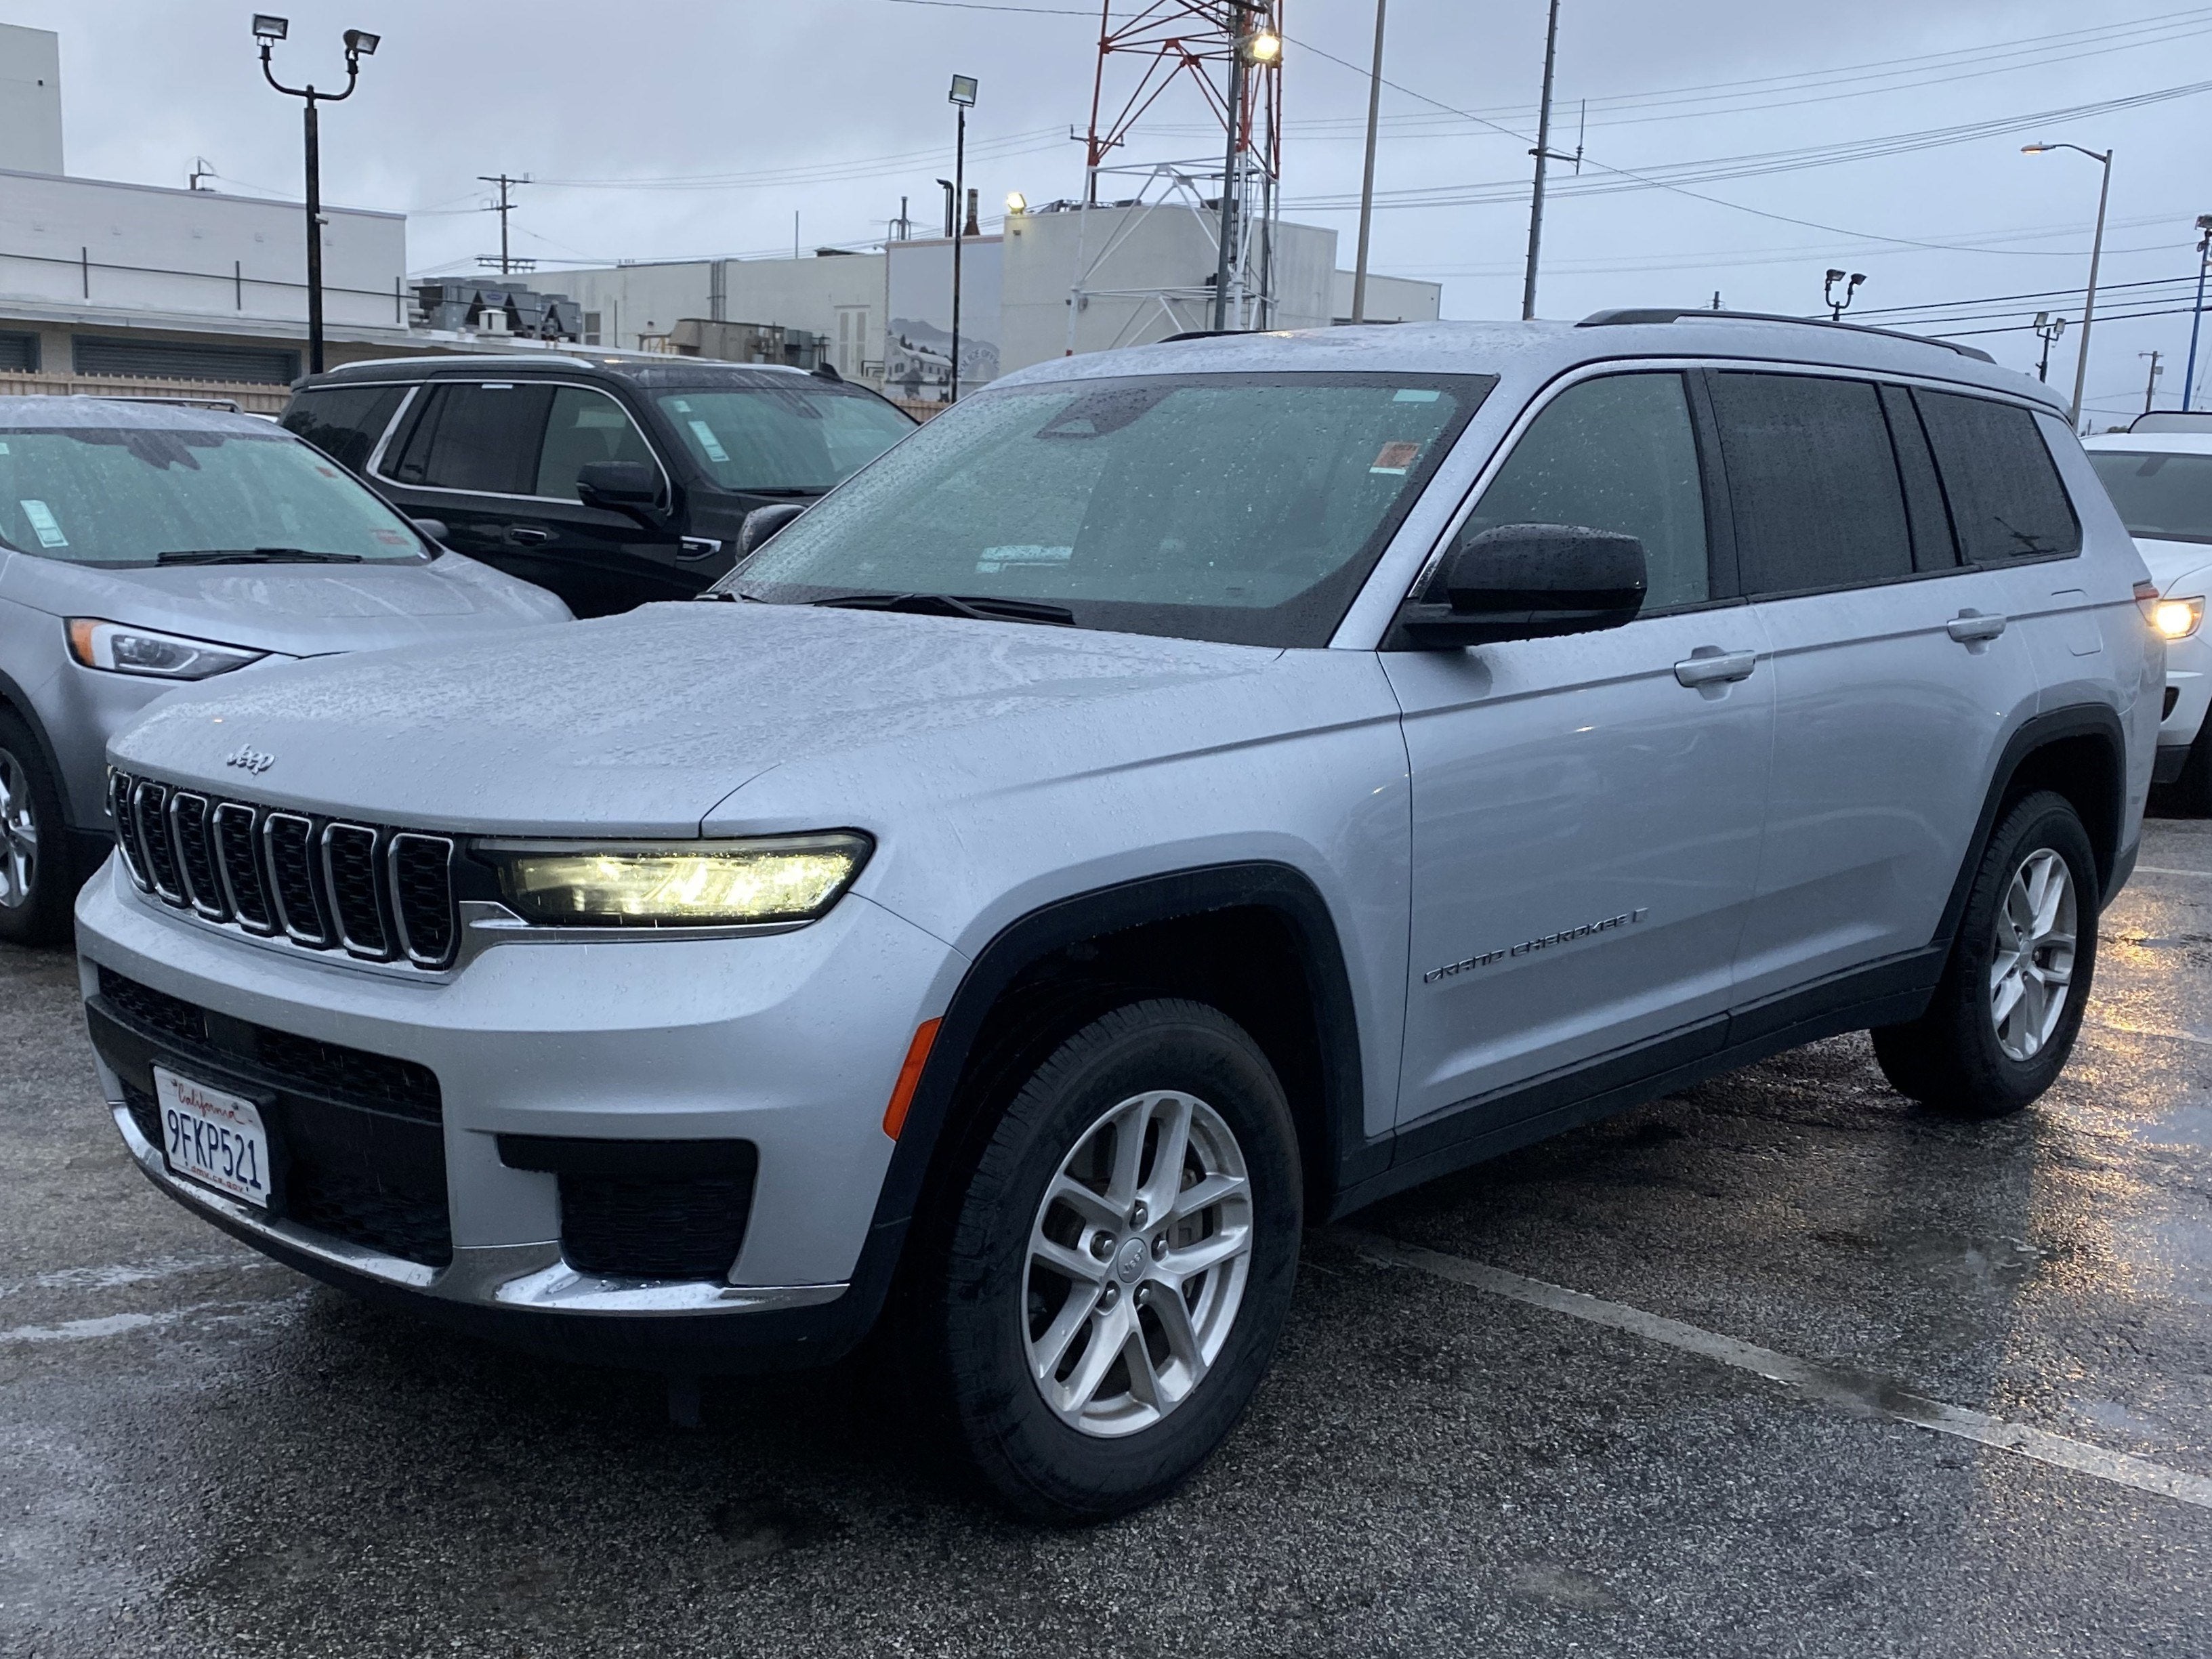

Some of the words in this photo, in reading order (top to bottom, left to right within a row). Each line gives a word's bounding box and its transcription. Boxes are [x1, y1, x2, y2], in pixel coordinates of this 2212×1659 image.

[226, 744, 275, 776] Jeep
[1424, 949, 1505, 983] GRAND
[1511, 913, 1628, 957] CHEROKEE
[178, 1083, 245, 1125] California
[167, 1109, 262, 1190] 9FKP521
[191, 1165, 243, 1193] dmv.ca.gov
